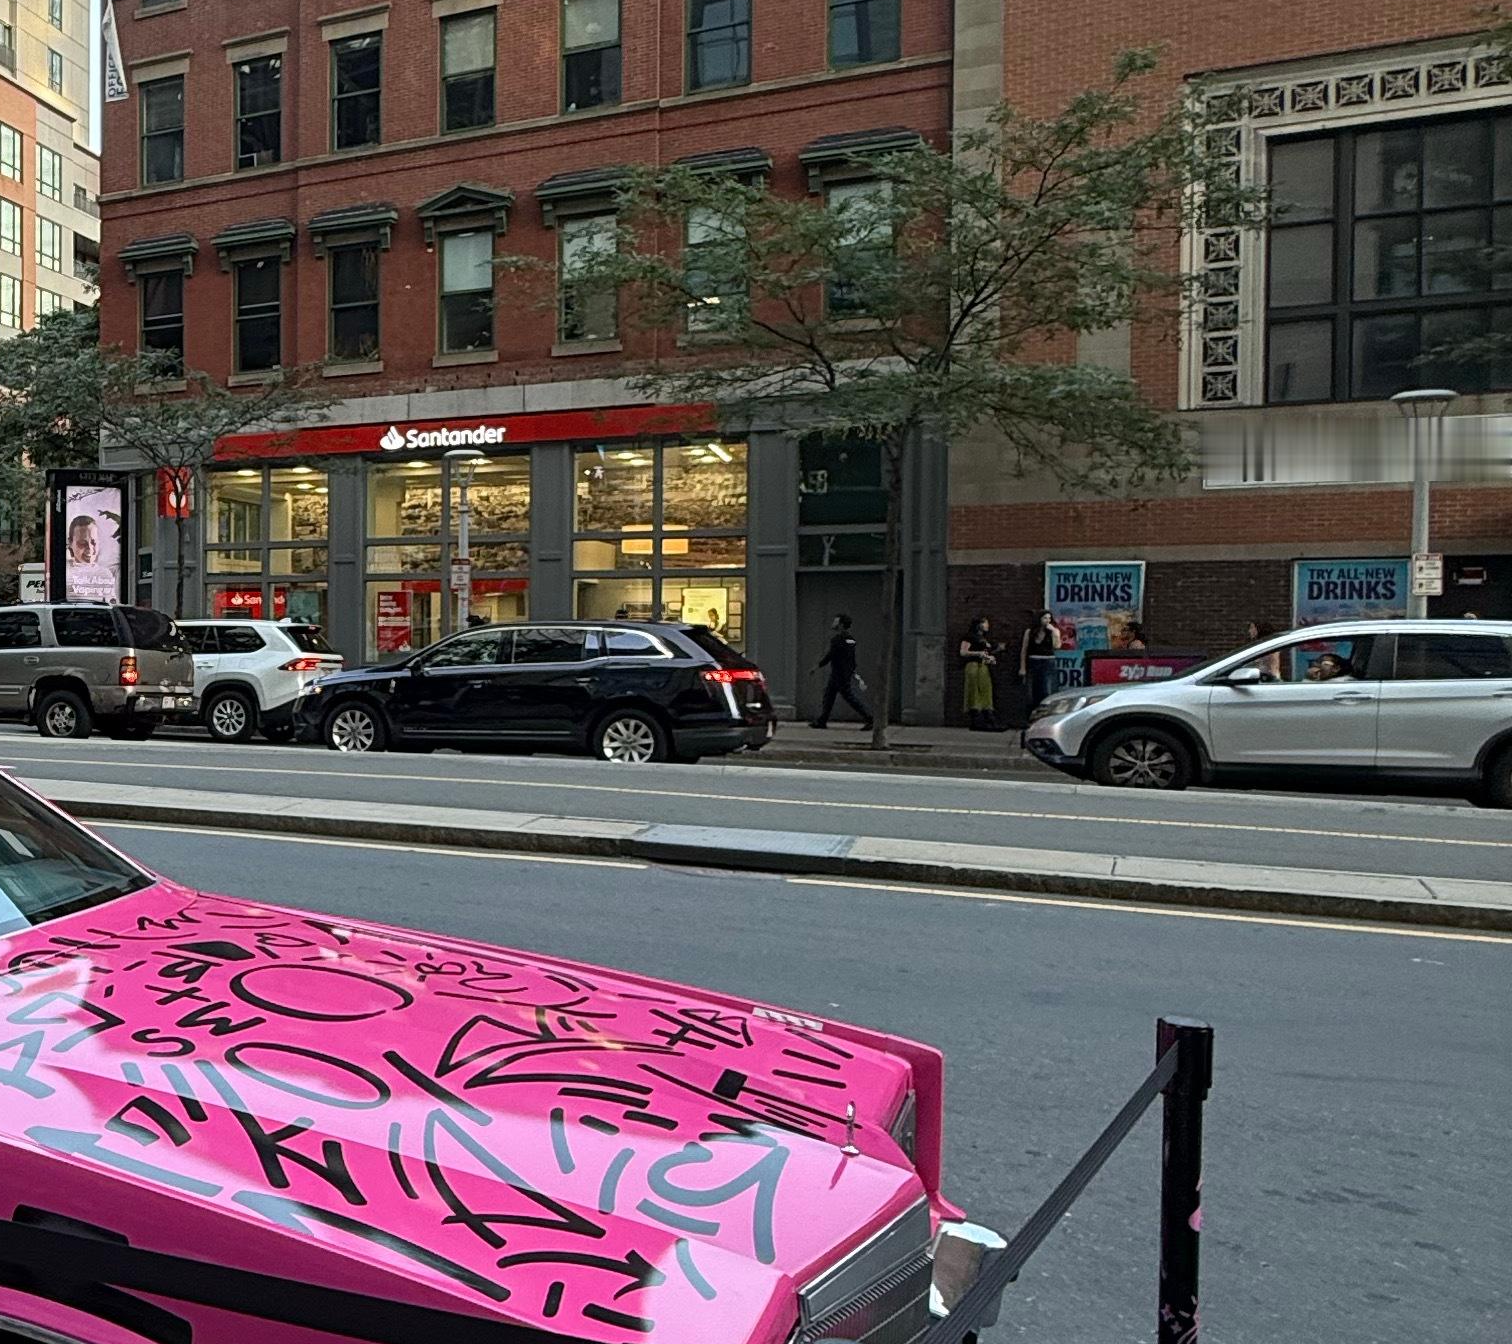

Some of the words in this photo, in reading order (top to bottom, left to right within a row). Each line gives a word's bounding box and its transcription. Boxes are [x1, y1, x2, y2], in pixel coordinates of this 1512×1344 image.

[405, 425, 506, 449] Santander
[1056, 572, 1080, 584] TRY
[1082, 571, 1133, 583] ALL-NEW
[1308, 568, 1333, 580] TRY
[1338, 567, 1396, 580] ALL-NEW
[1056, 583, 1133, 603] DRINKS
[1307, 580, 1396, 601] DRINKS
